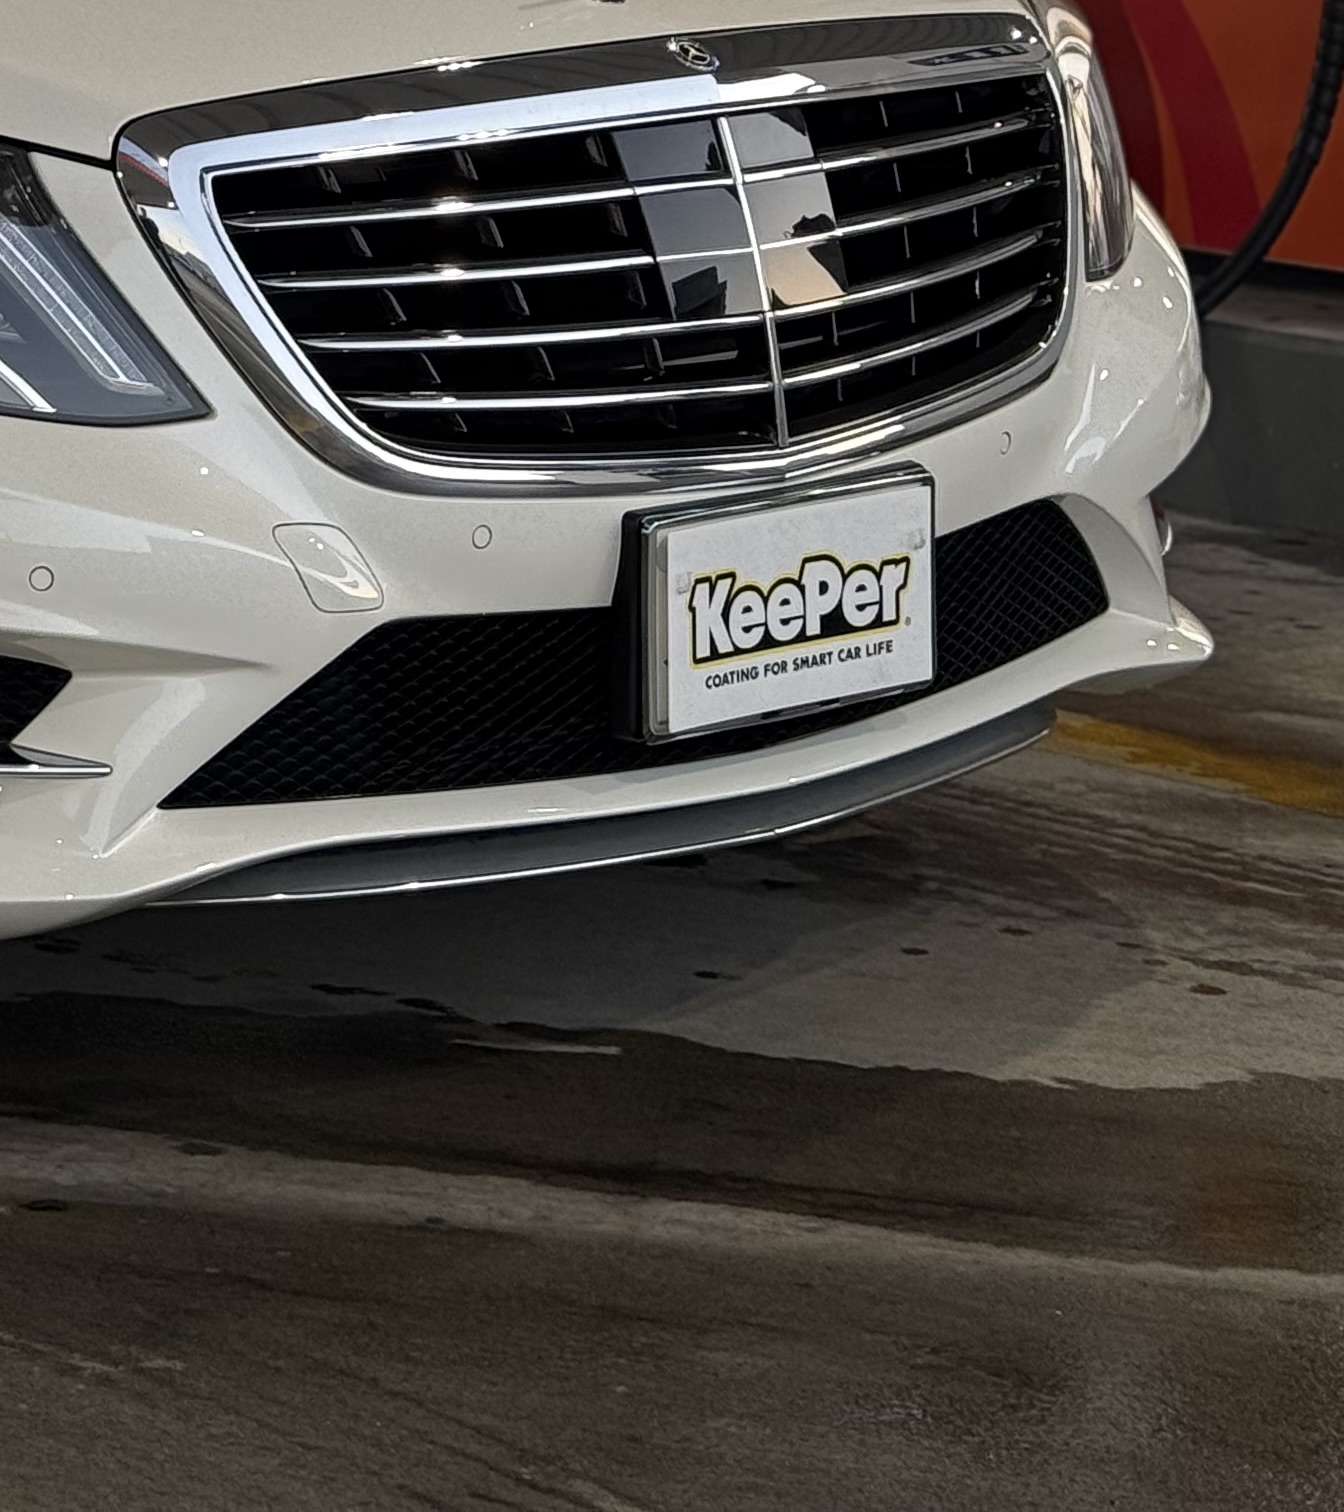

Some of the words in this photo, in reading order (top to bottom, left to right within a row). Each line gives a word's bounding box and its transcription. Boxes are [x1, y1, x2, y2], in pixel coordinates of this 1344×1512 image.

[689, 554, 911, 664] KeePer
[705, 664, 759, 690] COATING
[763, 657, 788, 677] FOR
[792, 651, 833, 673] SMART
[837, 645, 862, 664] CAR
[865, 639, 894, 657] LIFE
